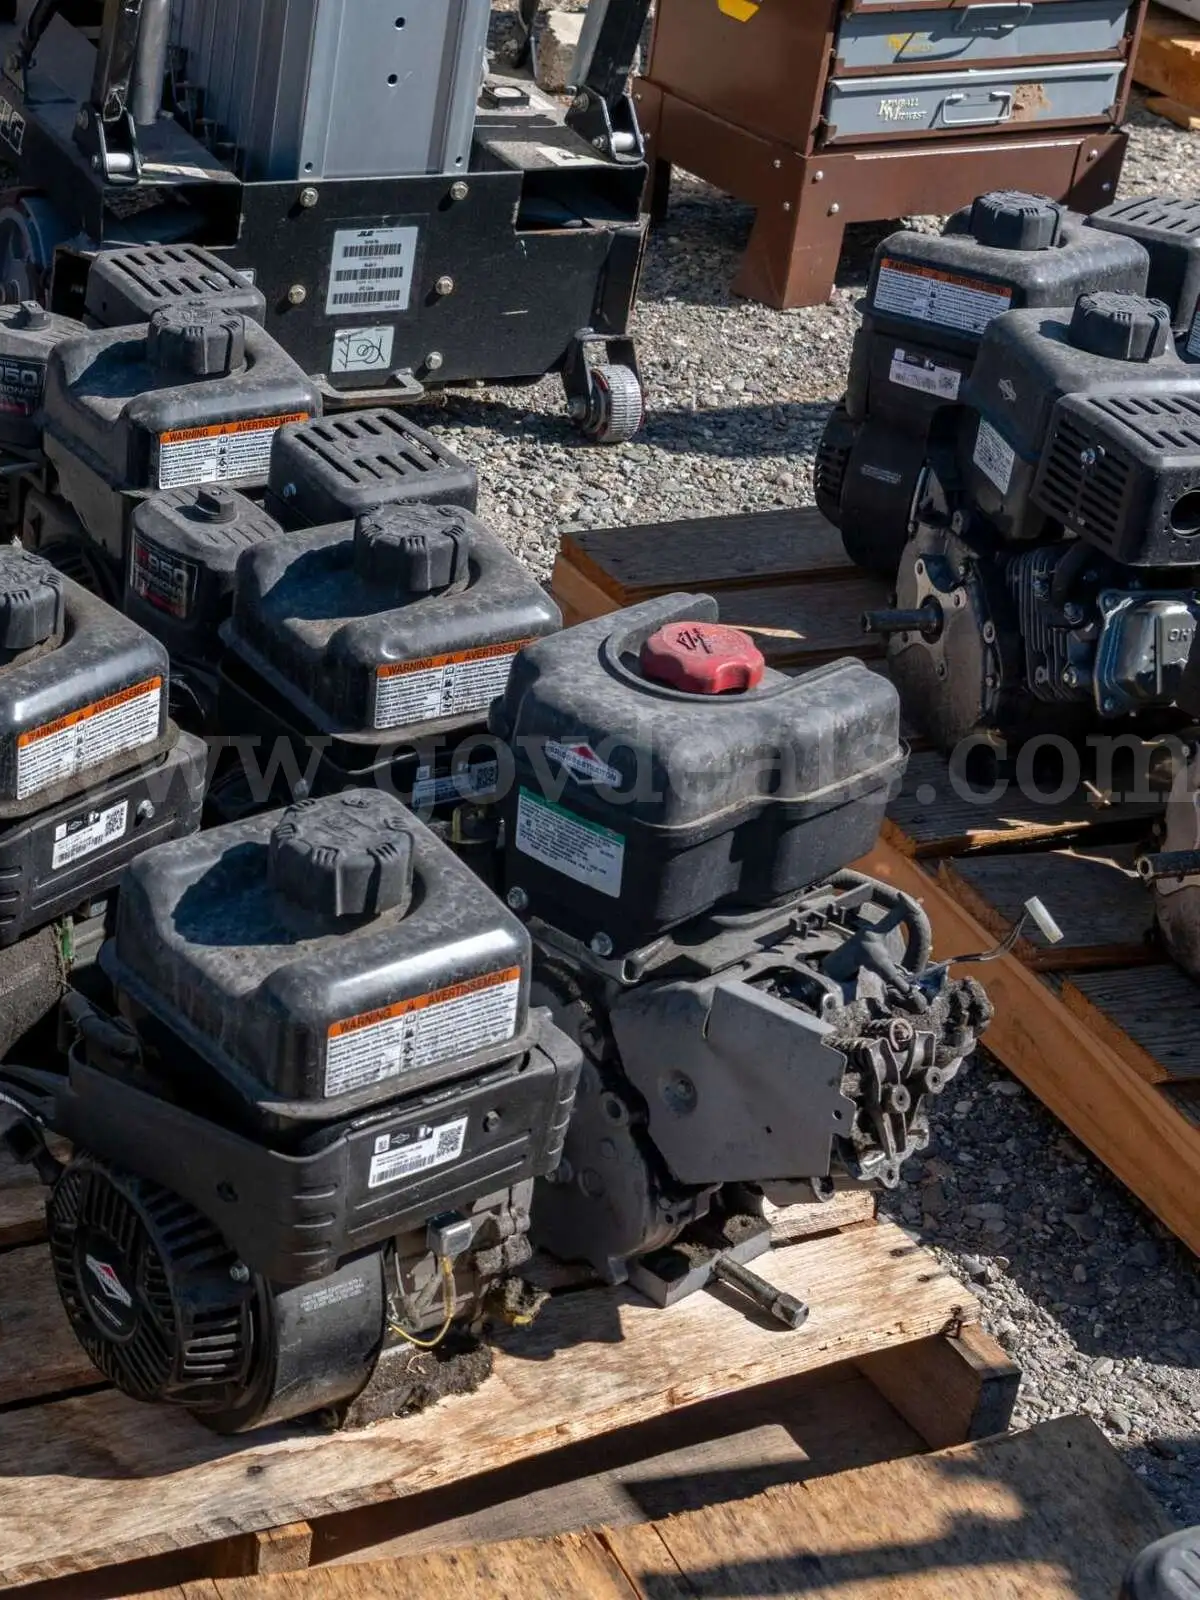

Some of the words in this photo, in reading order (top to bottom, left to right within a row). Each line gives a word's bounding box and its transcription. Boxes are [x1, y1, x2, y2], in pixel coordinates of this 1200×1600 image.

[169, 428, 208, 442] WARNING
[388, 658, 433, 675] WARNING
[27, 719, 67, 742] WARNING
[340, 1007, 392, 1033] WARNING
[428, 970, 512, 1003] AVERTISSEMENT
